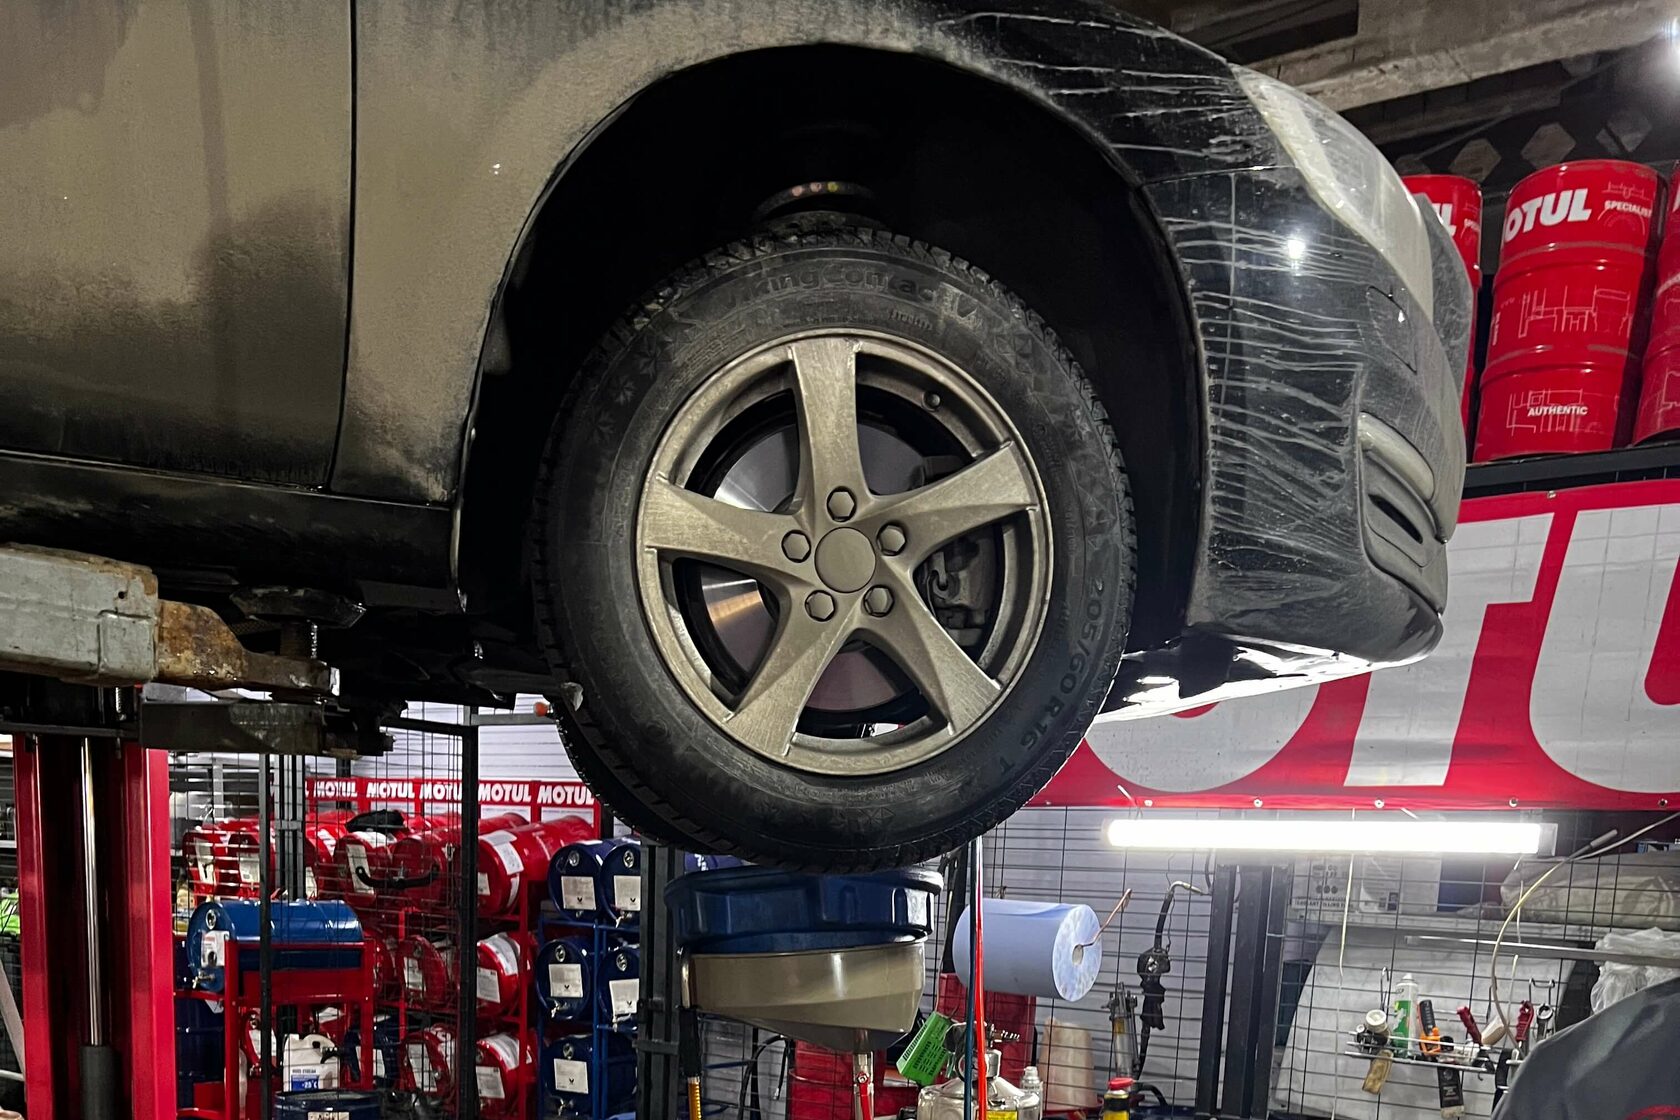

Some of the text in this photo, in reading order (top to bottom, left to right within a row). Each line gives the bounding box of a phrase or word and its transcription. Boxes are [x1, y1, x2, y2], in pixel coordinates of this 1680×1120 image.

[1504, 188, 1592, 243] OTUL
[1527, 405, 1589, 417] AUTHENTIC
[313, 781, 358, 798] MOTUL
[366, 782, 416, 799] MOTUL
[419, 783, 463, 801] MOTU
[478, 783, 532, 802] MOTUL
[537, 785, 595, 805] MOTUL
